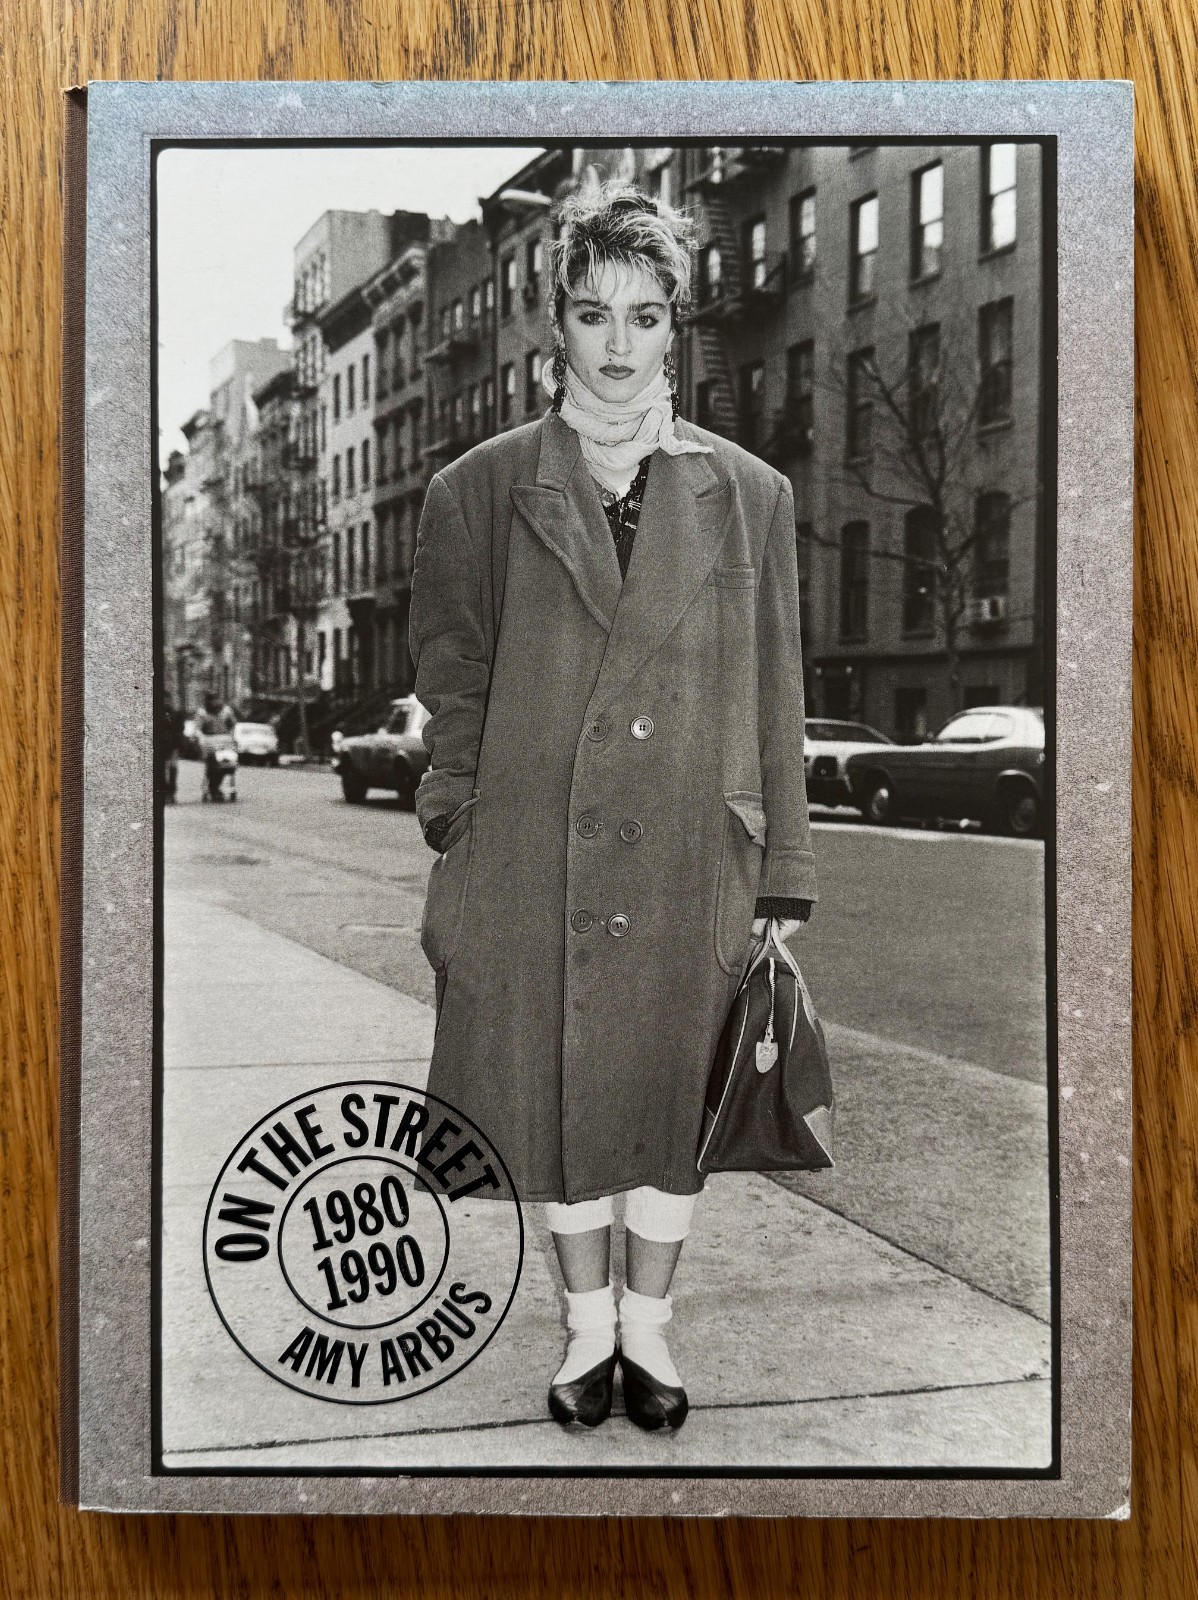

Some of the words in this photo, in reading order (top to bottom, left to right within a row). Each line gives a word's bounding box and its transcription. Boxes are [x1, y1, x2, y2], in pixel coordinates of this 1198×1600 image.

[237, 1103, 336, 1191] THE
[340, 1092, 502, 1203] STREET
[214, 1192, 276, 1262] ON
[303, 1175, 410, 1252] 1980
[316, 1234, 425, 1311] 1990
[278, 1325, 370, 1388] AMY
[380, 1281, 493, 1387] ARBUS
